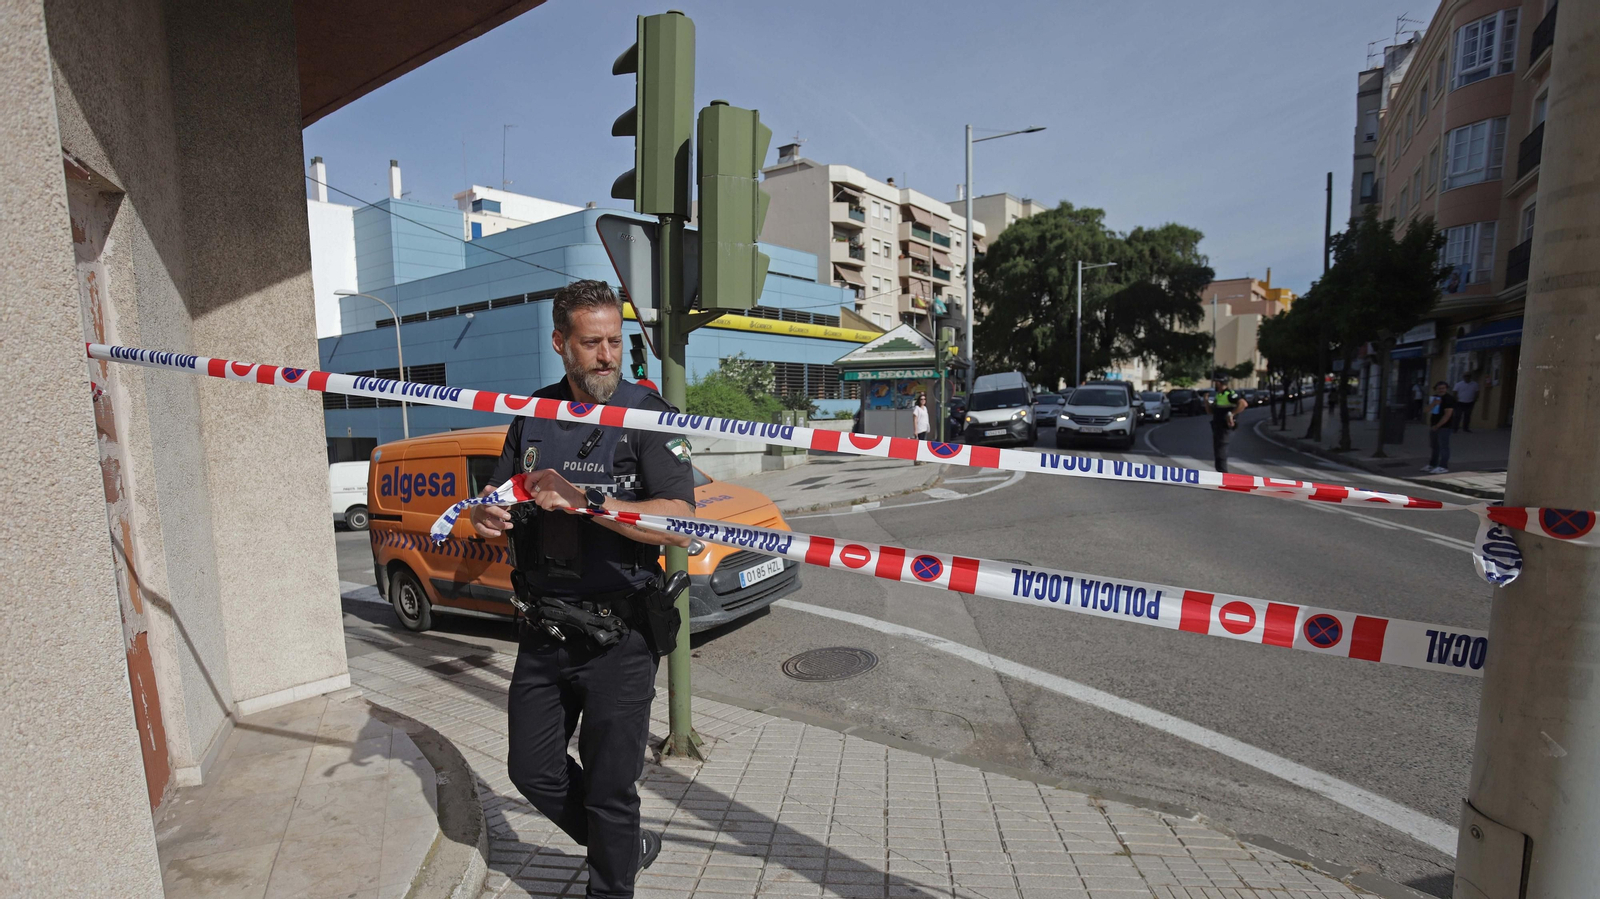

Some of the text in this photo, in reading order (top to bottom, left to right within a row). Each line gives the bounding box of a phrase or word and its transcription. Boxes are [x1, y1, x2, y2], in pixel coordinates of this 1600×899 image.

[755, 321, 773, 330] CORREOS
[857, 369, 934, 380] EL SECANO
[563, 461, 605, 473] POLICIA
[381, 466, 456, 503] algesa
[696, 494, 734, 508] gesa
[746, 560, 781, 582] 0185 HZL
[1011, 567, 1163, 620] POLICIA LOCAL
[1425, 629, 1488, 670] OCAL
